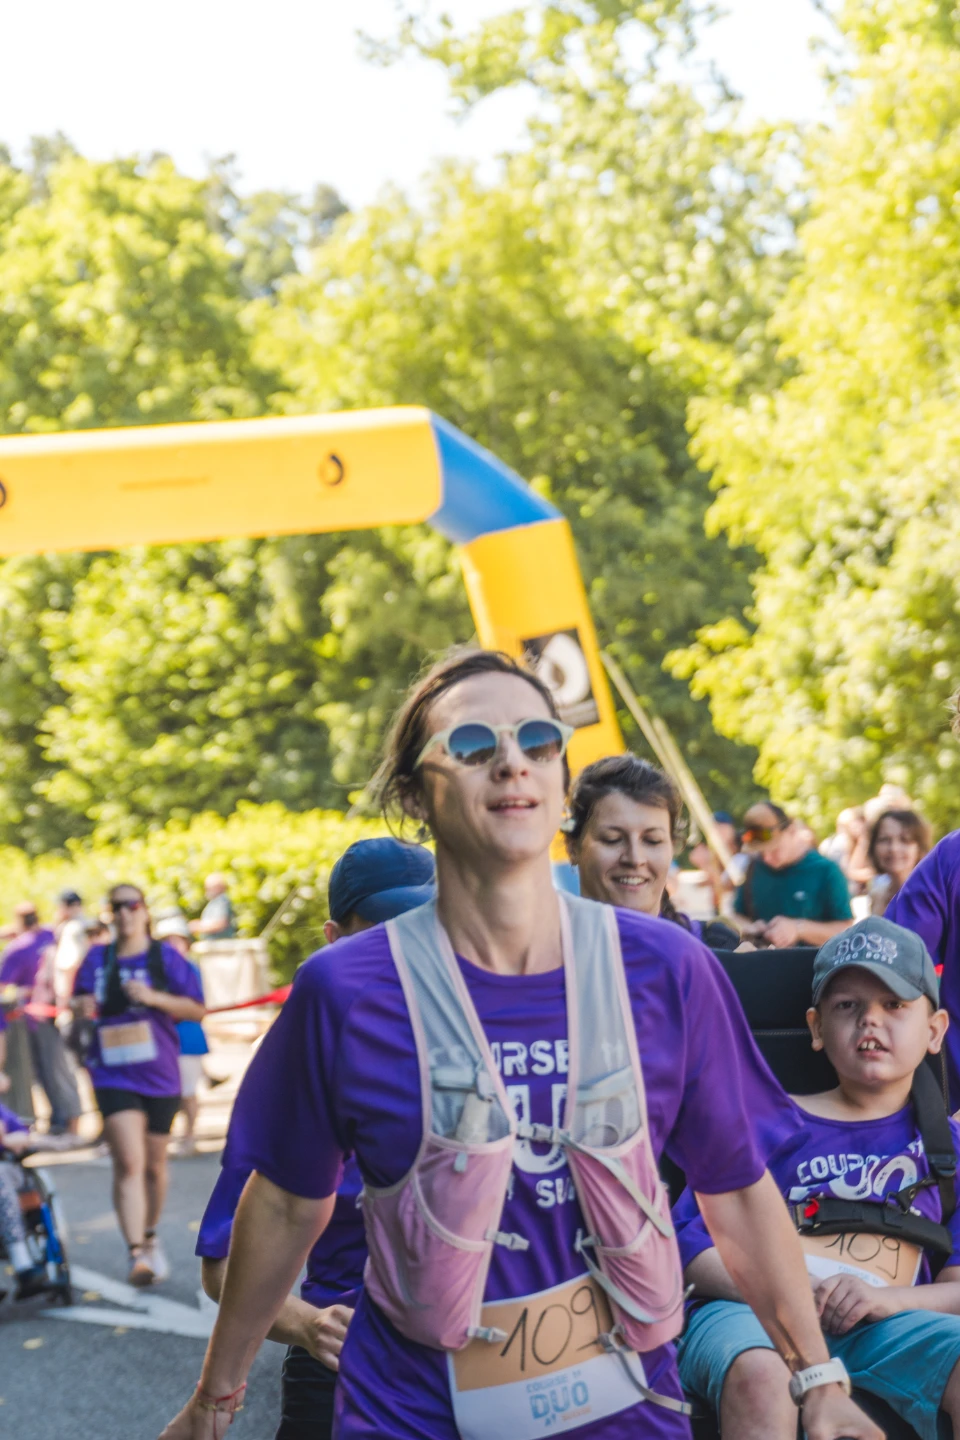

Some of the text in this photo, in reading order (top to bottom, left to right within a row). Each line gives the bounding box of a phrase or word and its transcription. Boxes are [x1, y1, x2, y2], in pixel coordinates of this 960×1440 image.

[834, 932, 898, 960] BOSS
[824, 1232, 900, 1280] 109
[500, 1285, 603, 1371] 109
[529, 1380, 589, 1420] DUO
